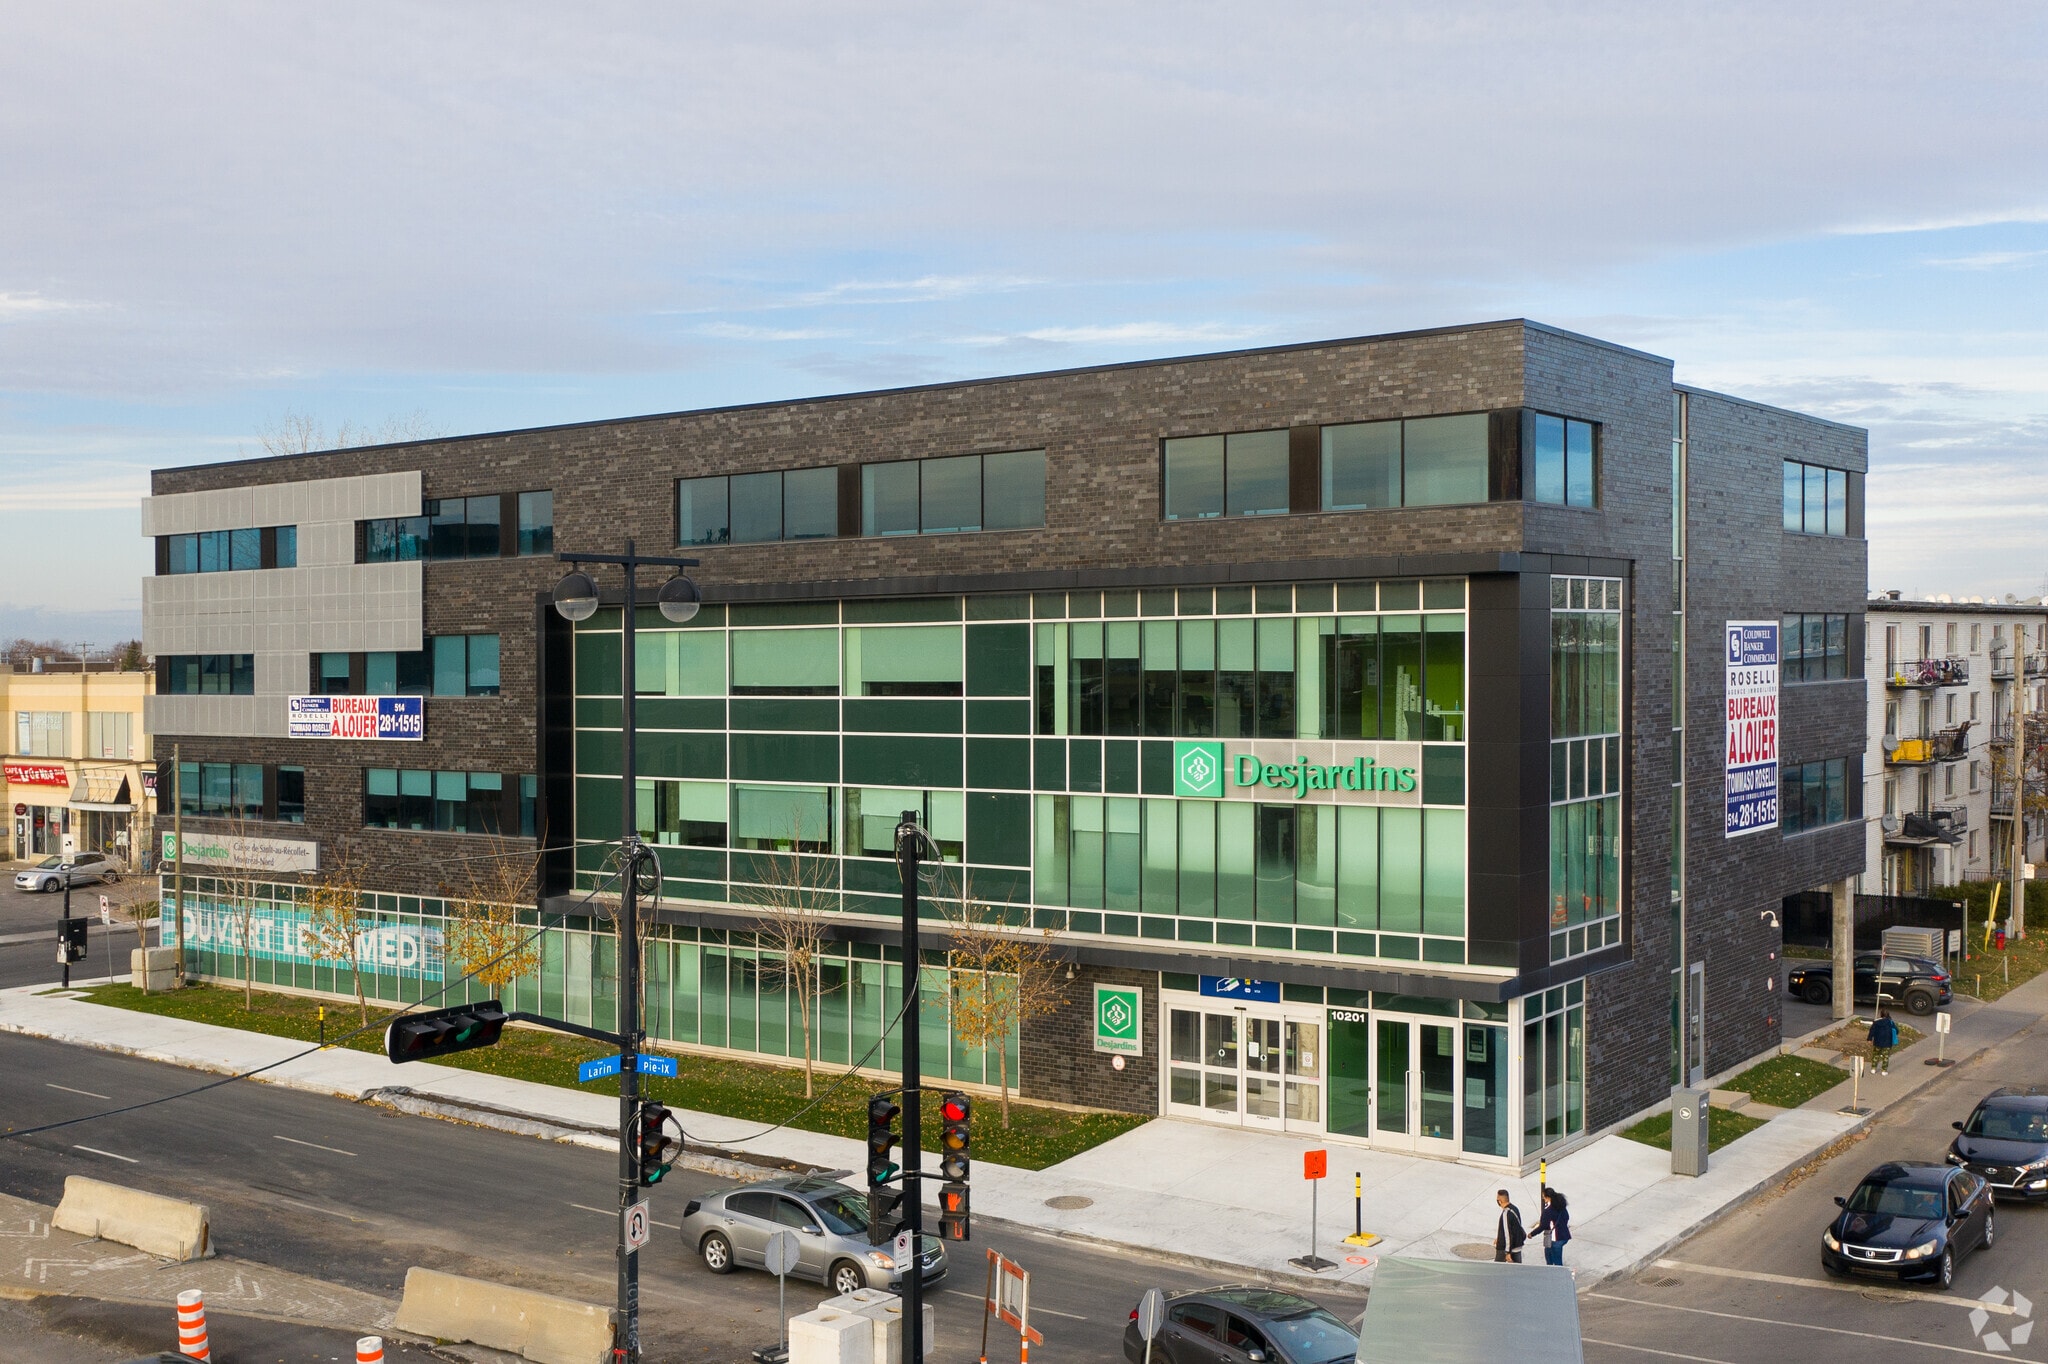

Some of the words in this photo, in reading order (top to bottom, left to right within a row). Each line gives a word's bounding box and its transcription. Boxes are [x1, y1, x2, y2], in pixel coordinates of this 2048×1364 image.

[1744, 629, 1770, 639] COLDWELL
[1744, 642, 1763, 651] BANKER
[1744, 654, 1776, 663] COMMERCIAL
[1731, 670, 1775, 686] ROSELLI
[333, 698, 377, 714] BUREAUX
[394, 703, 405, 712] 514
[1728, 695, 1776, 720] BUREAUX
[331, 716, 340, 736] À
[342, 715, 377, 738] LOUER
[380, 714, 420, 732] 281-1515
[1728, 723, 1737, 764] À
[1739, 719, 1776, 763] LOUER
[1233, 754, 1417, 799] Desjardins
[1728, 770, 1754, 794] TOMMASO
[1755, 766, 1776, 789] ROSELLI
[1728, 812, 1738, 827] 514
[1739, 798, 1776, 826] 281-1515
[181, 841, 229, 861] Desjardins
[181, 910, 273, 951] OUVERT
[283, 921, 310, 954] LE
[1331, 1011, 1365, 1023] 10201
[1097, 1038, 1137, 1051] Desjardins
[588, 1064, 612, 1078] Larin
[643, 1061, 670, 1074] Pie-IX
